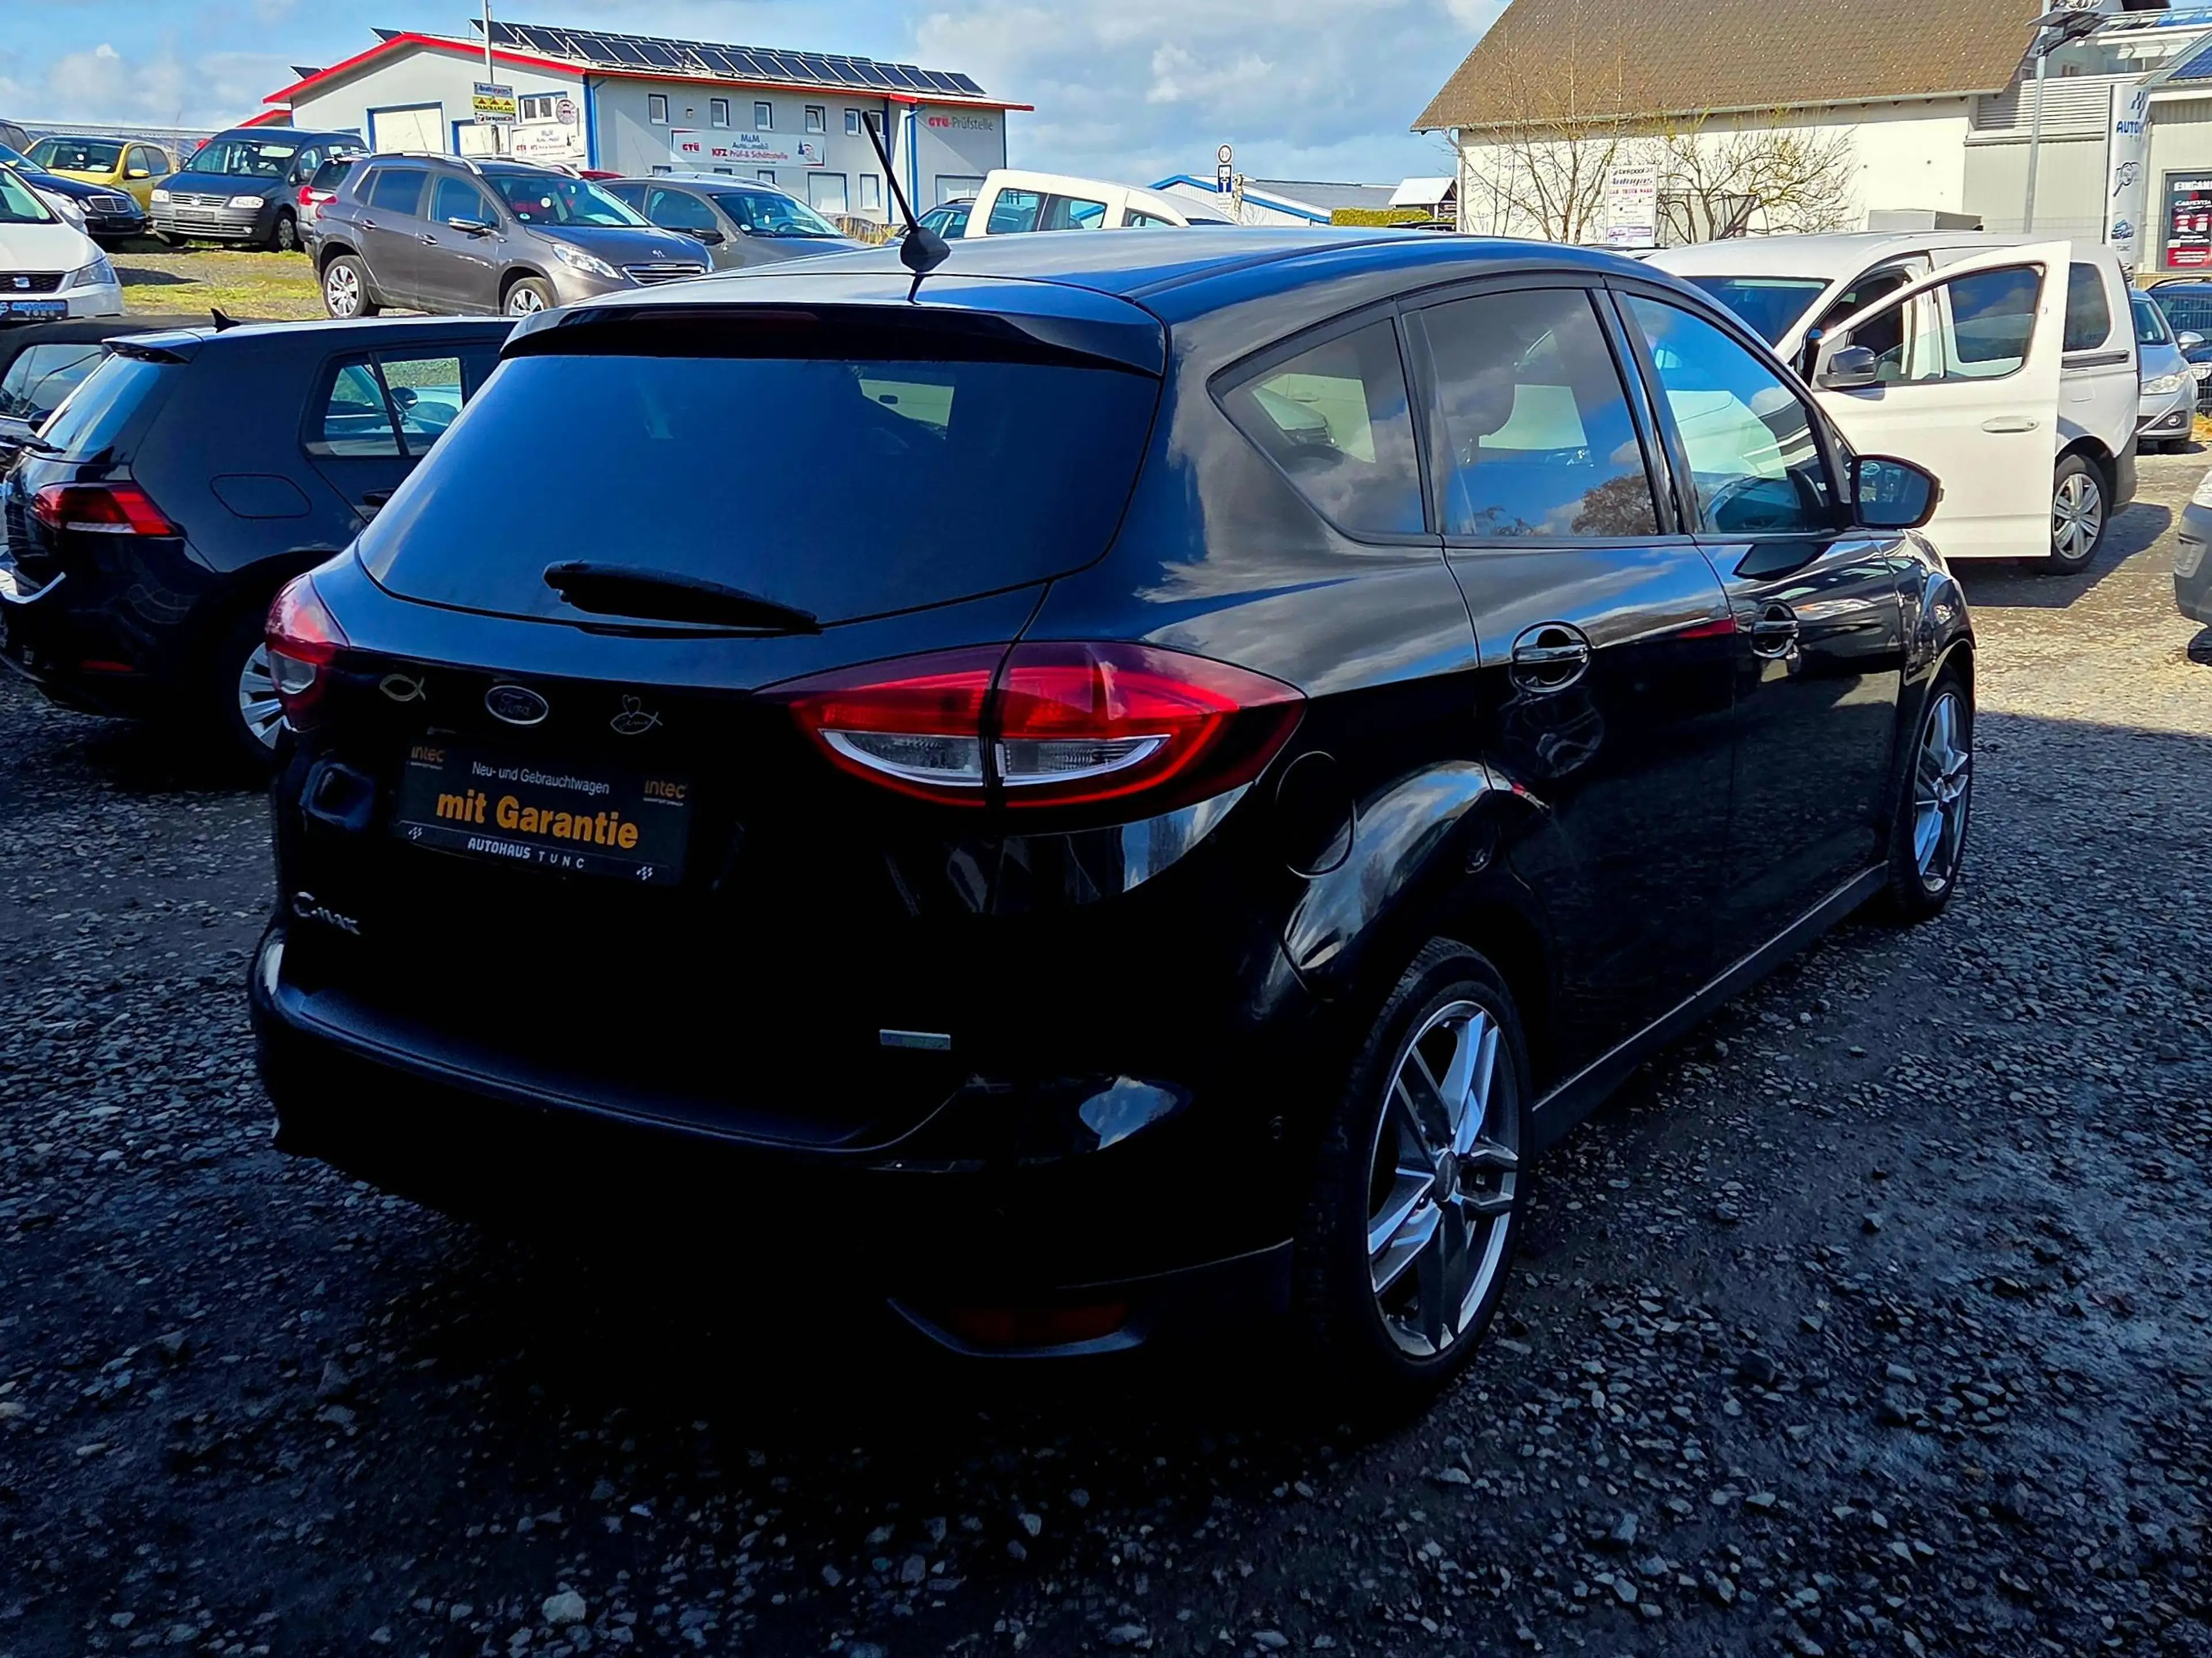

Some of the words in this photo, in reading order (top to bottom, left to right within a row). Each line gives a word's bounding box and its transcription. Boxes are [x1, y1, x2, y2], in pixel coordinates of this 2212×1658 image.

[472, 760, 497, 777] Neu-
[498, 767, 519, 781] und
[520, 768, 610, 796] Gebrauchtwagen
[435, 788, 488, 824] mit
[496, 794, 639, 849] Garantie
[467, 837, 532, 859] AUTOHAUS
